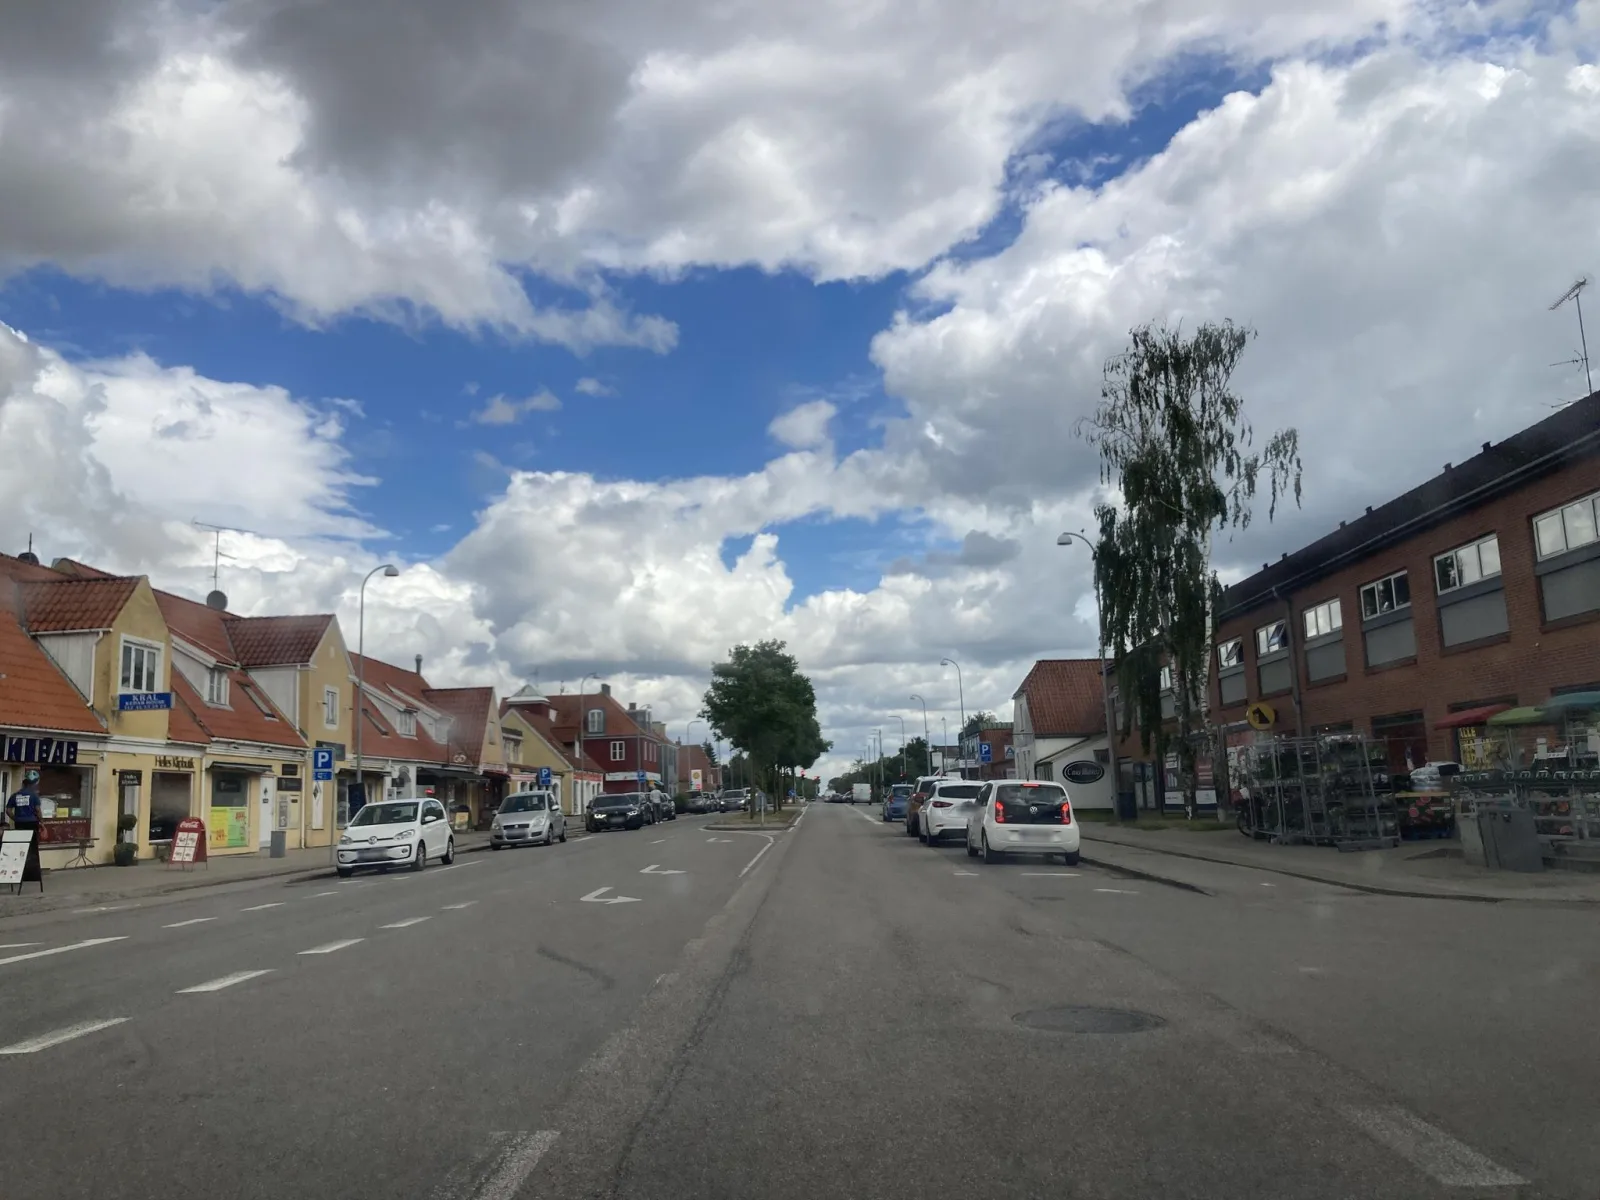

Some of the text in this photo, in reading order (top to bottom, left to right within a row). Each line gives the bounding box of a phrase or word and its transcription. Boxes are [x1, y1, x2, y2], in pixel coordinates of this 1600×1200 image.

[132, 693, 158, 701] KRAL
[982, 744, 989, 754] P
[318, 752, 329, 767] P
[541, 768, 548, 777] P
